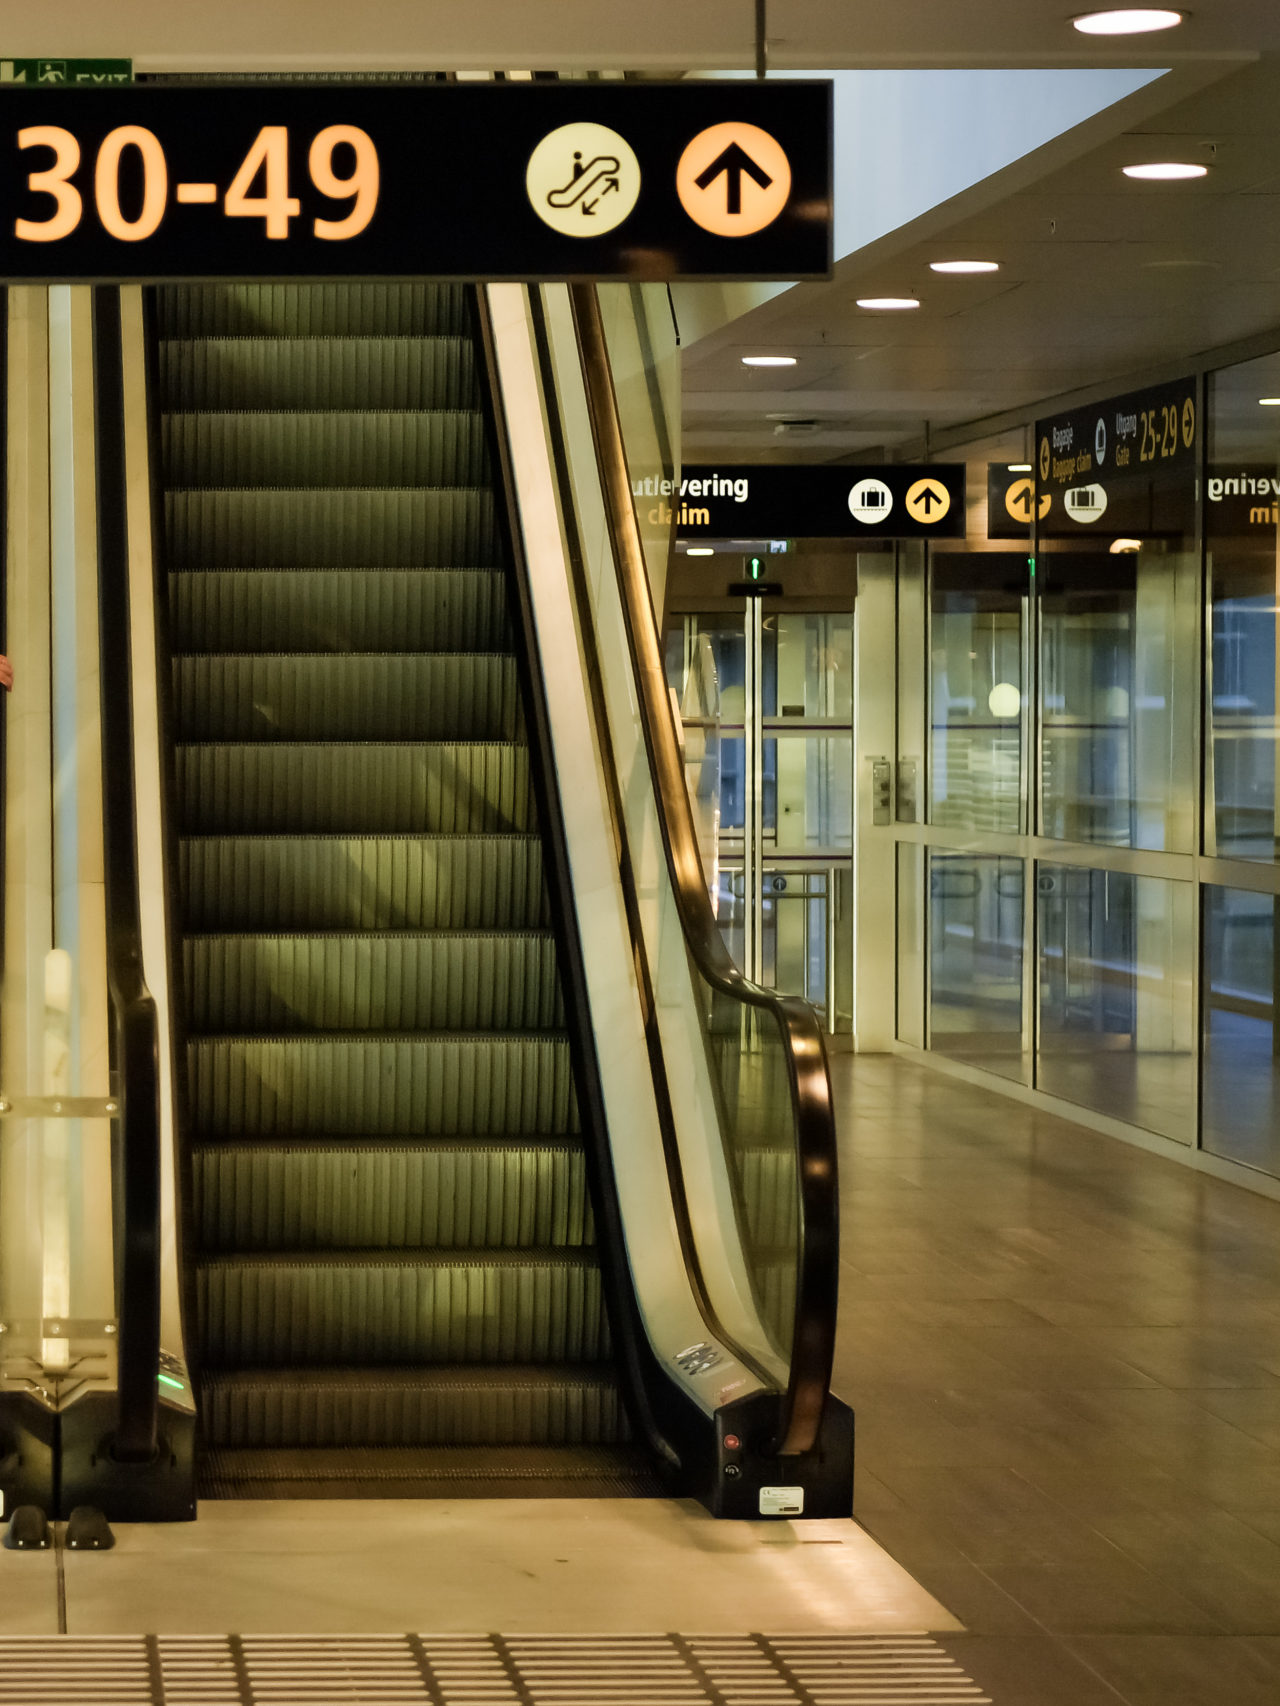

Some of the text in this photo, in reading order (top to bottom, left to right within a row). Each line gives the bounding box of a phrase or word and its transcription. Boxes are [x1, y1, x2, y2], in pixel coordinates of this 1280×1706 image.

[14, 124, 381, 242] 30-49
[1115, 444, 1130, 467] Gate
[1140, 404, 1178, 462] 25-29
